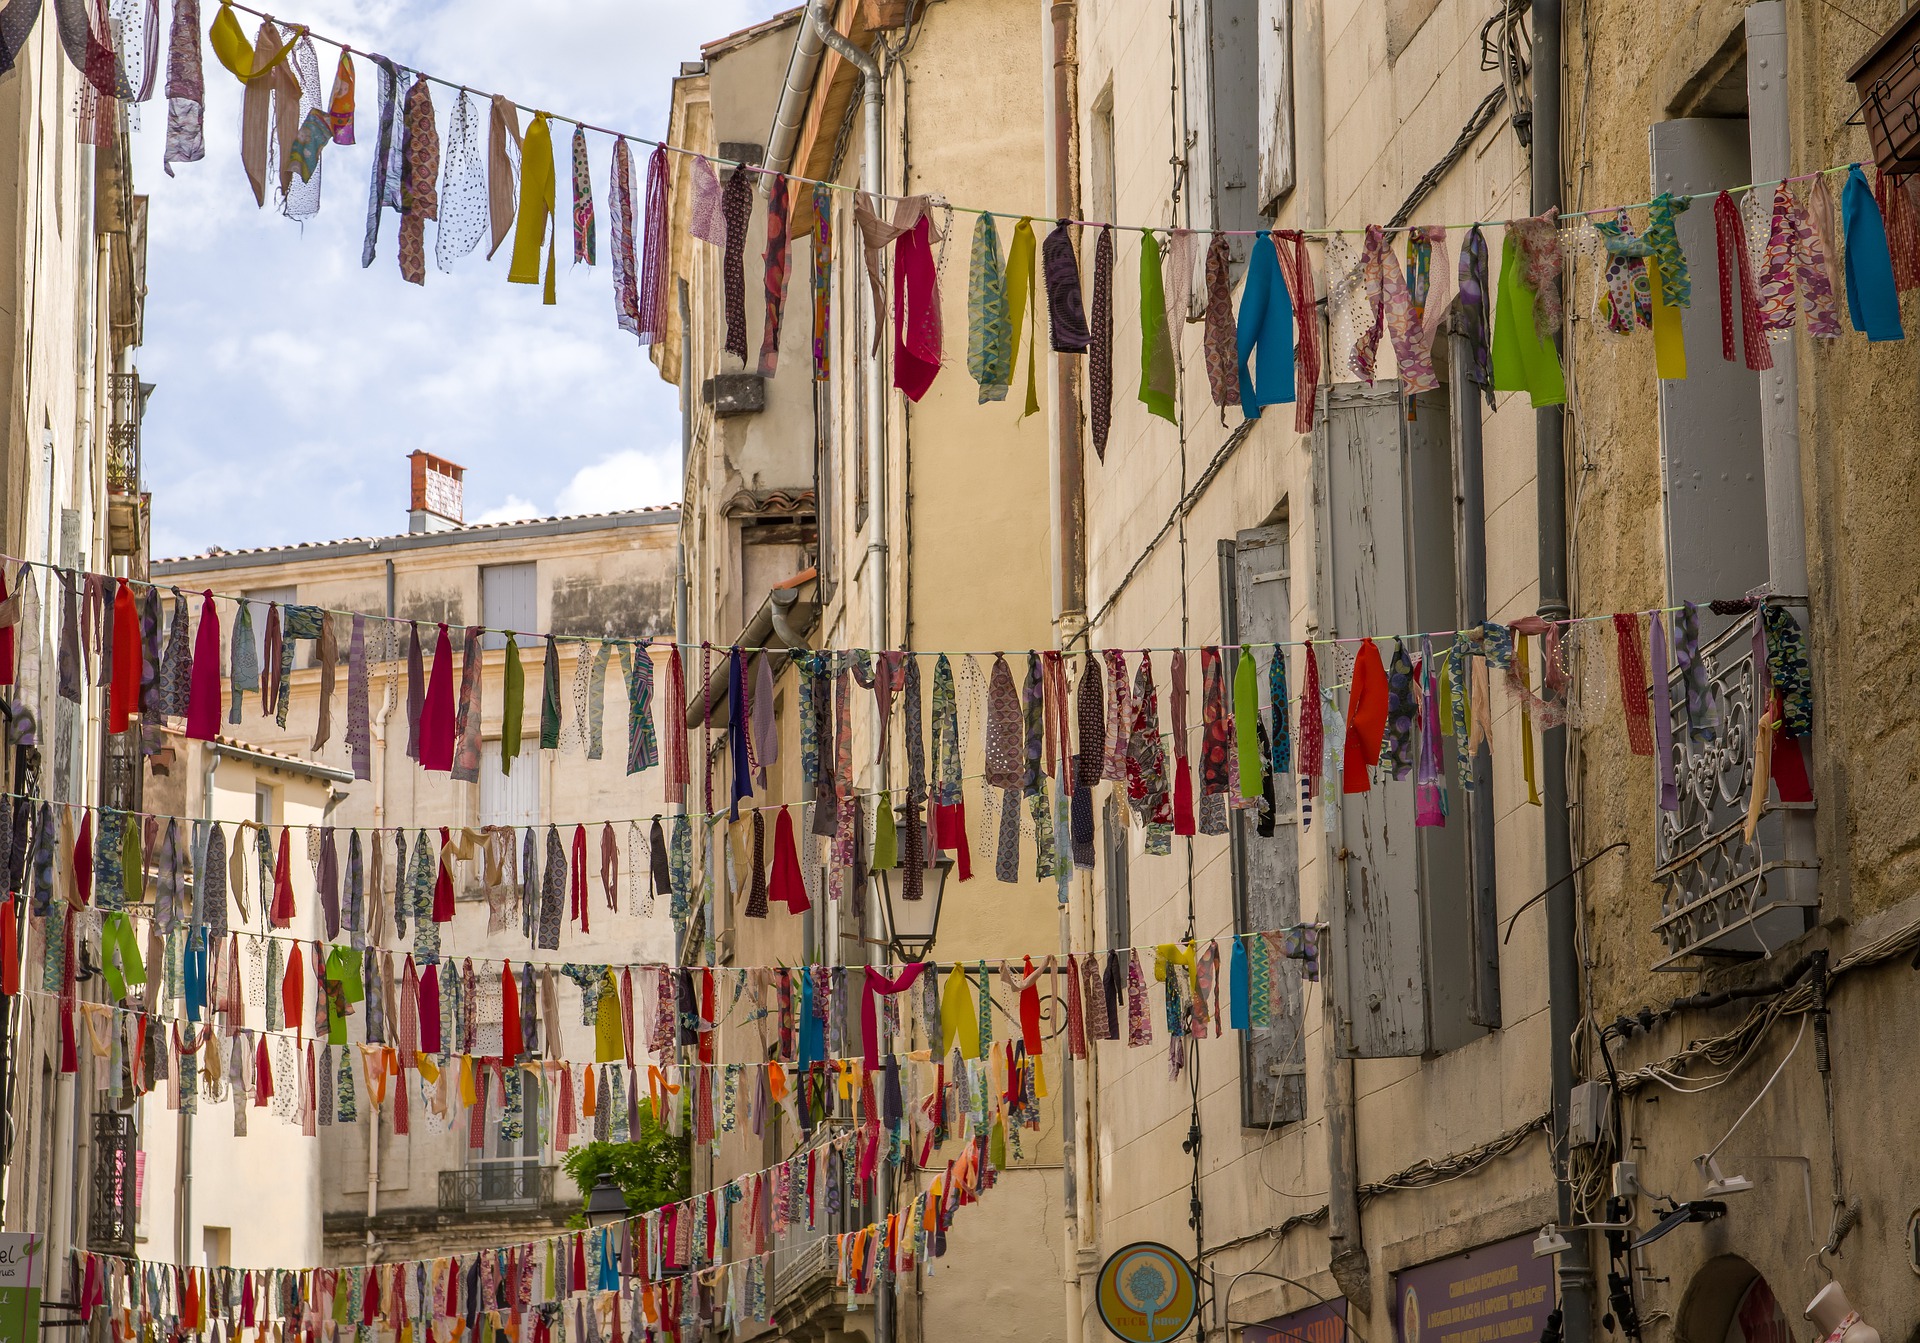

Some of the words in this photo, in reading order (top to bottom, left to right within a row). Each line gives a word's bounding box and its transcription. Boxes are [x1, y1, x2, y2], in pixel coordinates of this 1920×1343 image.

[1465, 1275, 1481, 1295] MAISON
[1452, 1307, 1460, 1323] SUR
[1461, 1303, 1473, 1321] PLACE
[1474, 1302, 1481, 1318] OU
[1485, 1295, 1508, 1314] EMPORTER
[1116, 1317, 1146, 1327] TUCK
[1154, 1317, 1181, 1327] SHOP
